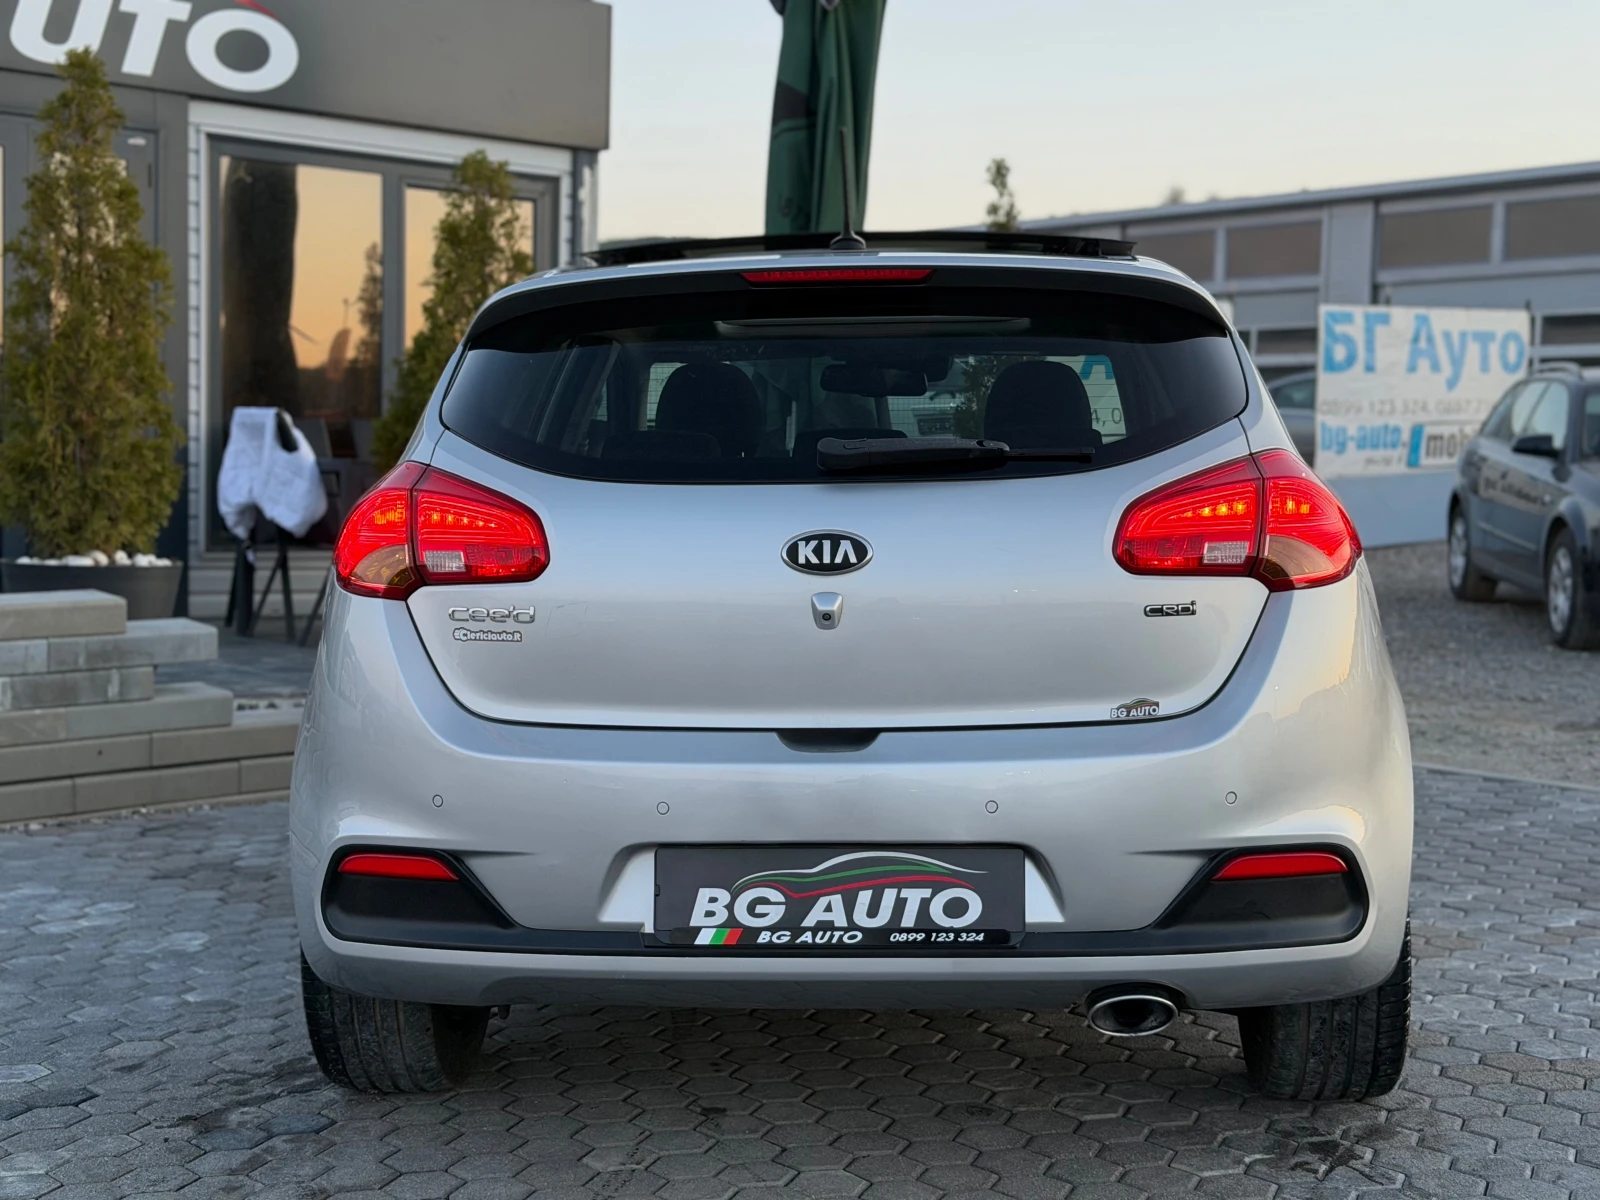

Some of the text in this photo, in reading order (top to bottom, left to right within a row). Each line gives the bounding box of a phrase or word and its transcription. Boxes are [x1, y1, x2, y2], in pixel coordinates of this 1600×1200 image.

[1322, 310, 1526, 391] БГ Ауто
[797, 540, 858, 564] KIA
[448, 605, 535, 624] cee'd
[1145, 601, 1196, 616] CRDi
[1110, 705, 1159, 718] BG AUTO
[689, 887, 983, 928] BG AUTO
[757, 931, 985, 943] BG AUTO 0899 123 324
